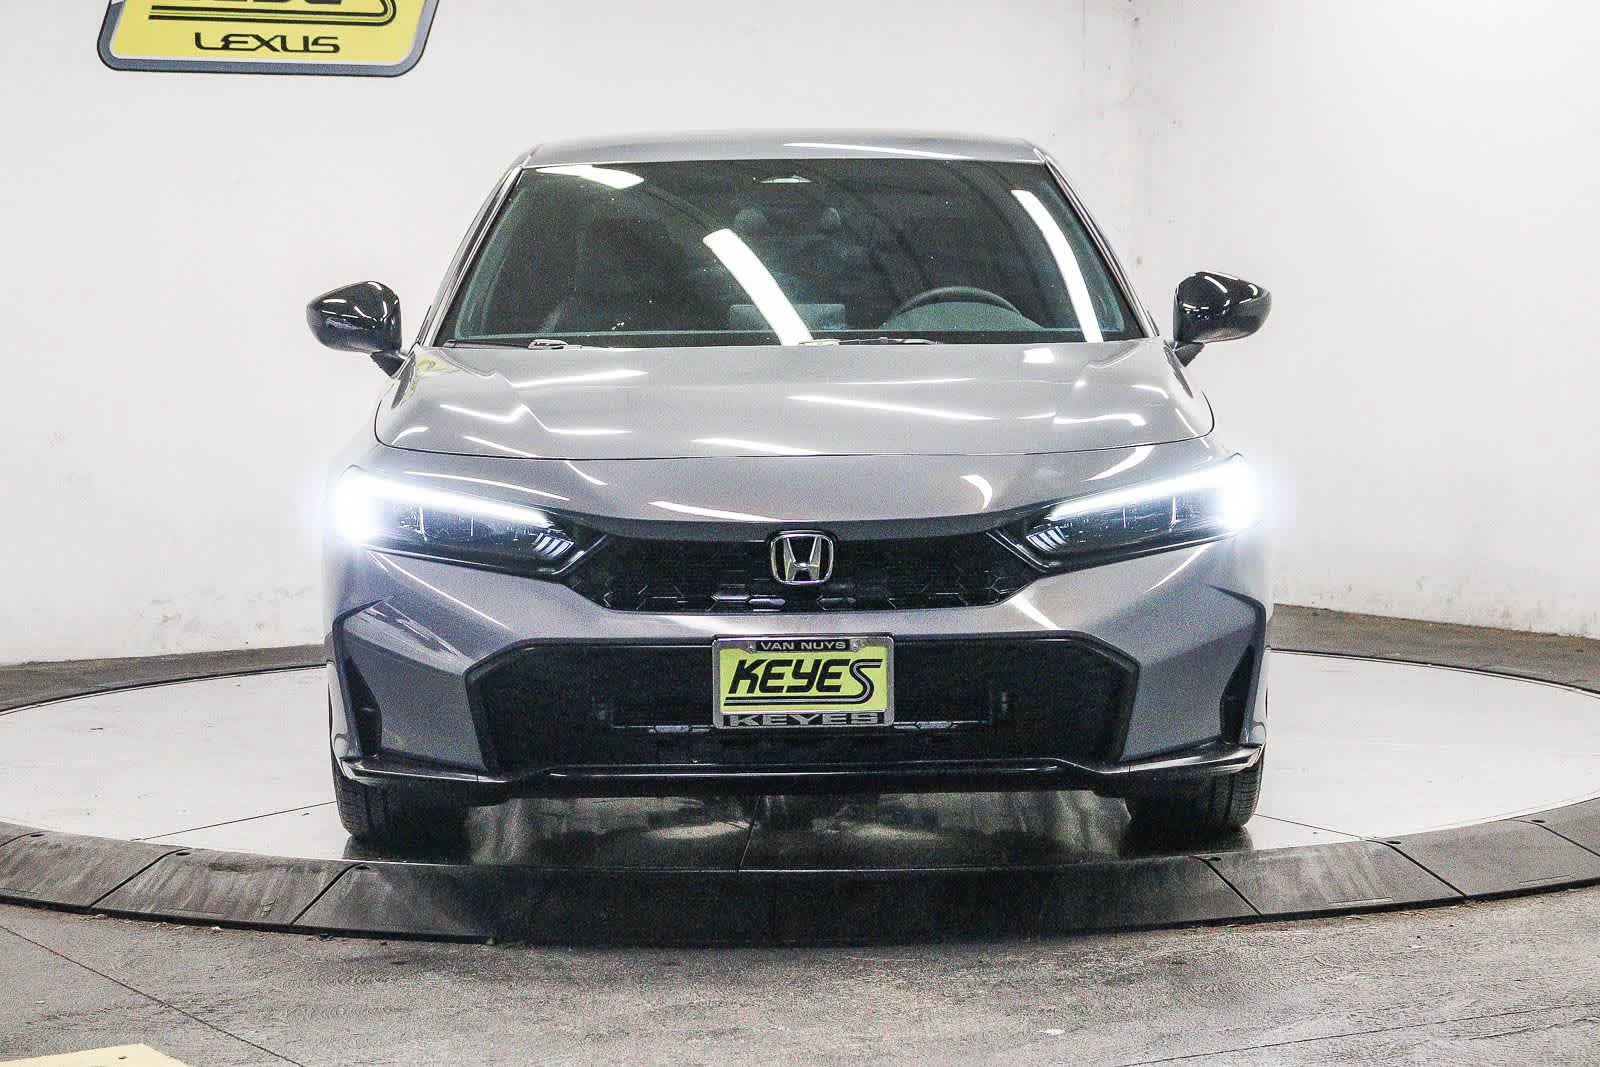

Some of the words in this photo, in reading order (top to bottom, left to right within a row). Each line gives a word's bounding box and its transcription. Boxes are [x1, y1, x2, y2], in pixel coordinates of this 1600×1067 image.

[194, 32, 341, 54] LEXUS
[760, 641, 796, 650] VAN
[800, 640, 847, 650] NUYS
[727, 658, 884, 705] KEYES
[729, 713, 879, 727] KEYES
